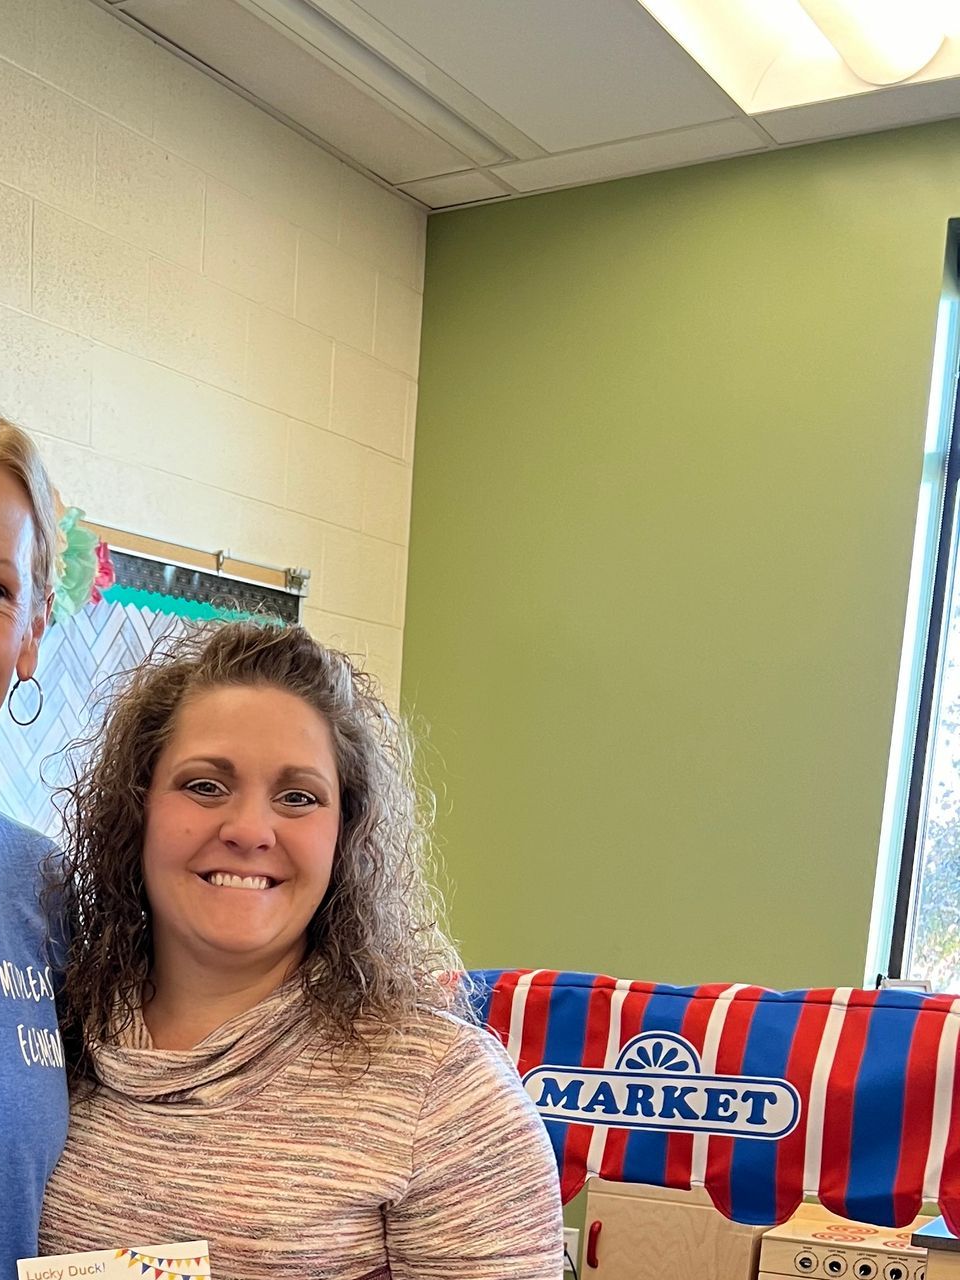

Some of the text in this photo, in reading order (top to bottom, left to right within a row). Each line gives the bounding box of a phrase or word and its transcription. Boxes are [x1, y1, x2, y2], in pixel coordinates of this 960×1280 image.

[17, 1023, 66, 1069] ELEMEN
[535, 1077, 778, 1126] MARKET
[26, 1262, 106, 1280] Lucky Duck!
